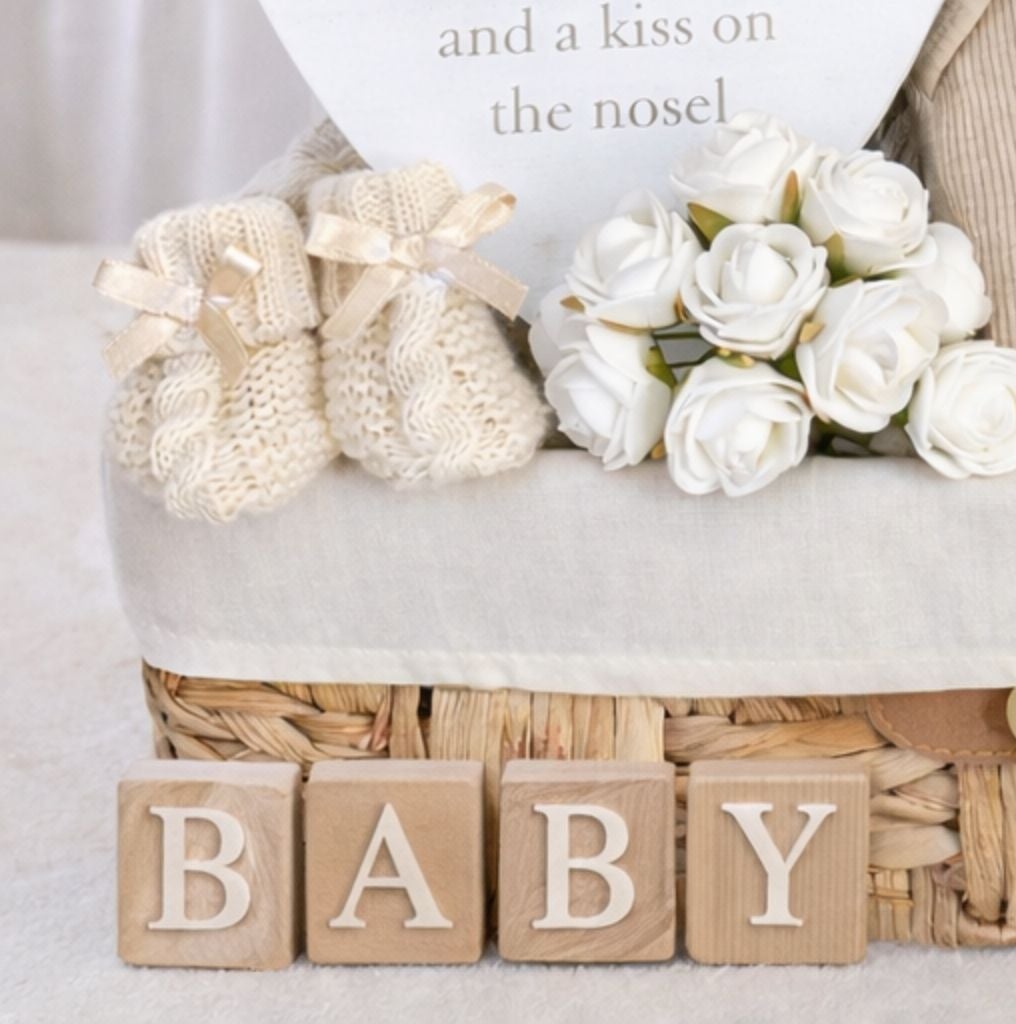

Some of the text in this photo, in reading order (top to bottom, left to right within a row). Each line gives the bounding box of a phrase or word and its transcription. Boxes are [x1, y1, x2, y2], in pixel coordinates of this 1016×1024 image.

[438, 3, 776, 58] and a kiss on
[491, 85, 573, 135] the
